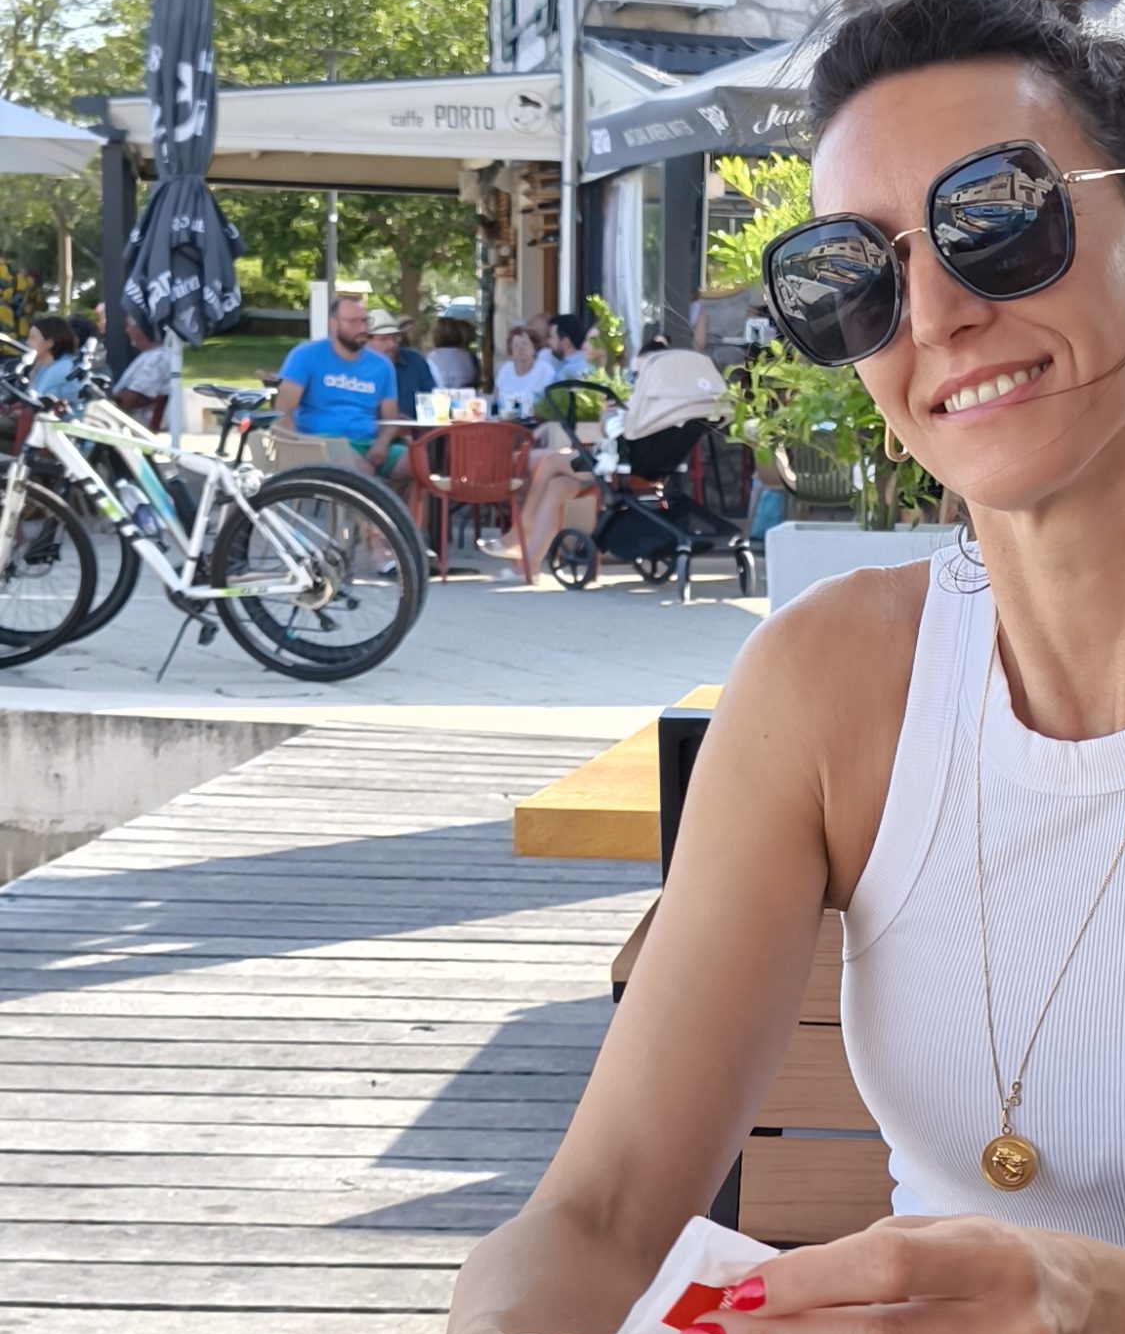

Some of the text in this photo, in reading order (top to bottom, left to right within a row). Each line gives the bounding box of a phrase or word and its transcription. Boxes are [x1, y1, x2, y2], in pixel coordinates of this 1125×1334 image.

[391, 104, 495, 130] caffe PORTO
[323, 373, 376, 394] adidas
